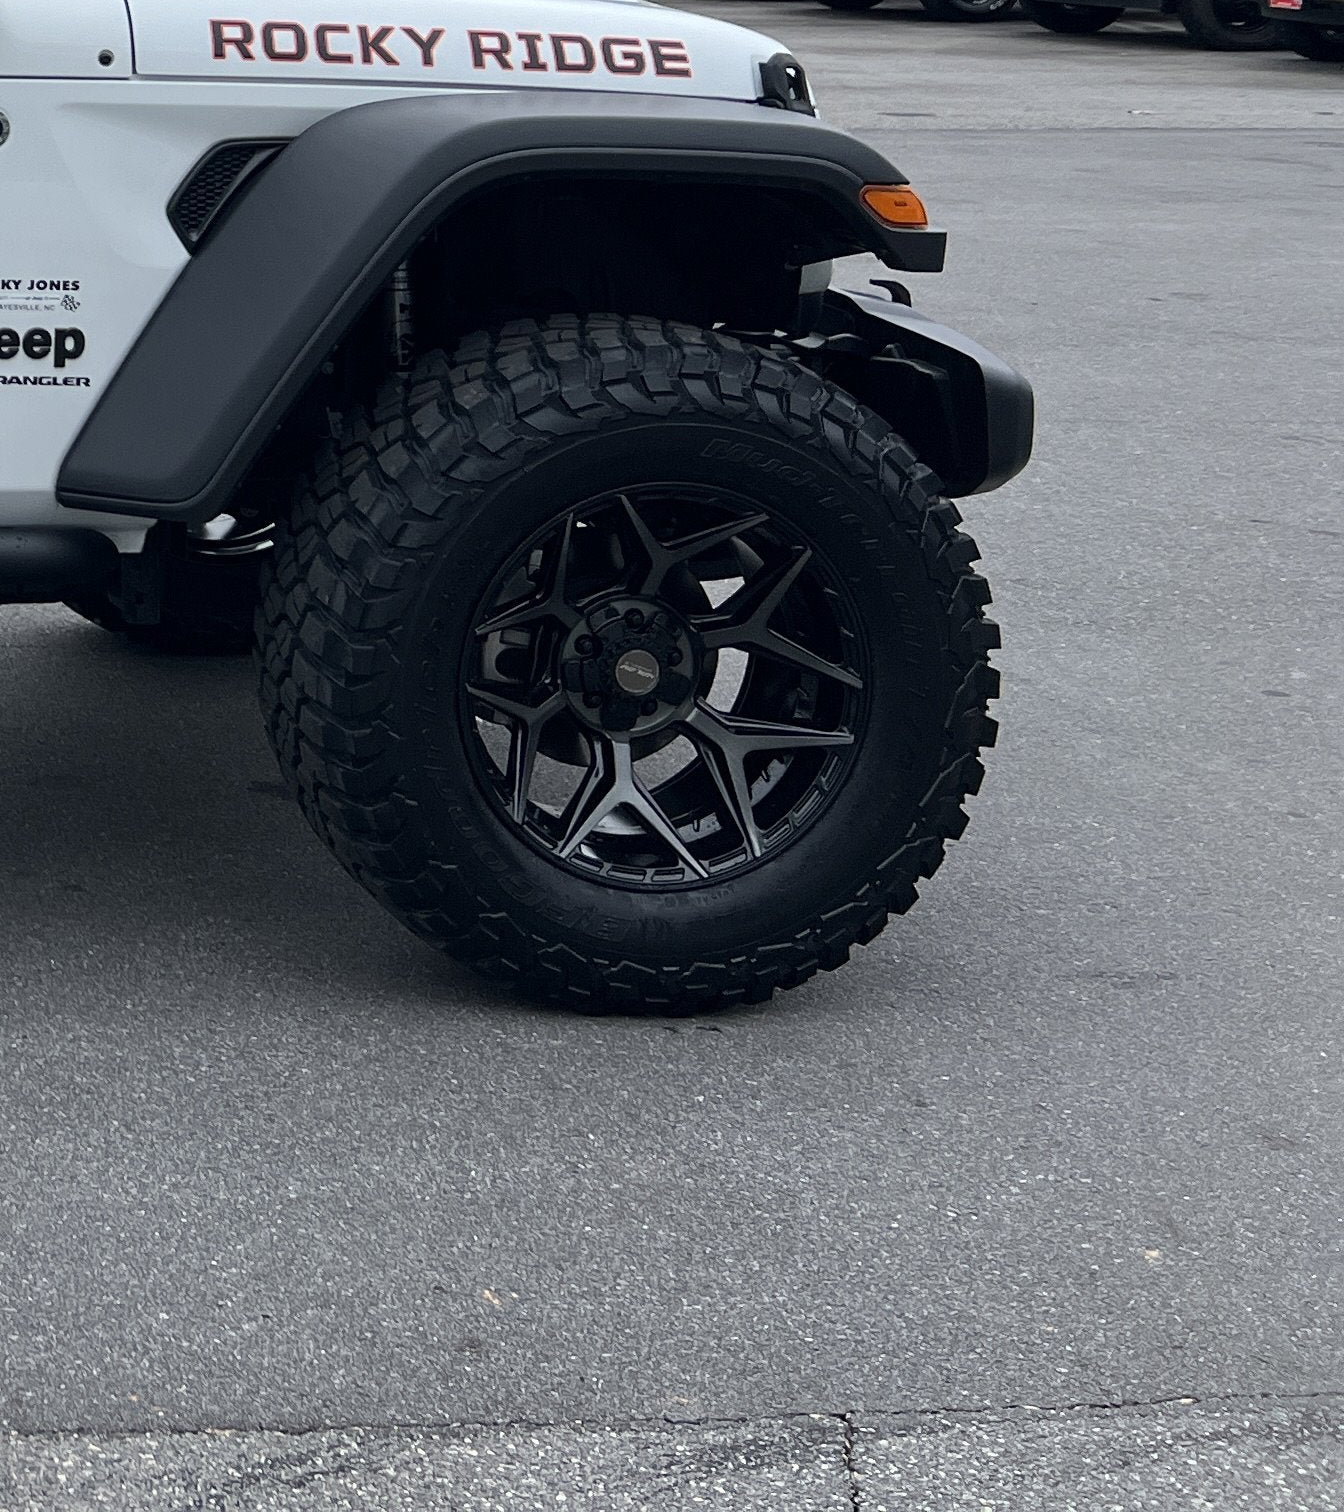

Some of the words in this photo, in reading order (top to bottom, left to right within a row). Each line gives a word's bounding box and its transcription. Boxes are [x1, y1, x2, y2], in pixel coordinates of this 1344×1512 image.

[209, 18, 446, 67] ROCKY
[467, 29, 693, 78] RIDGE
[27, 279, 80, 291] JONES
